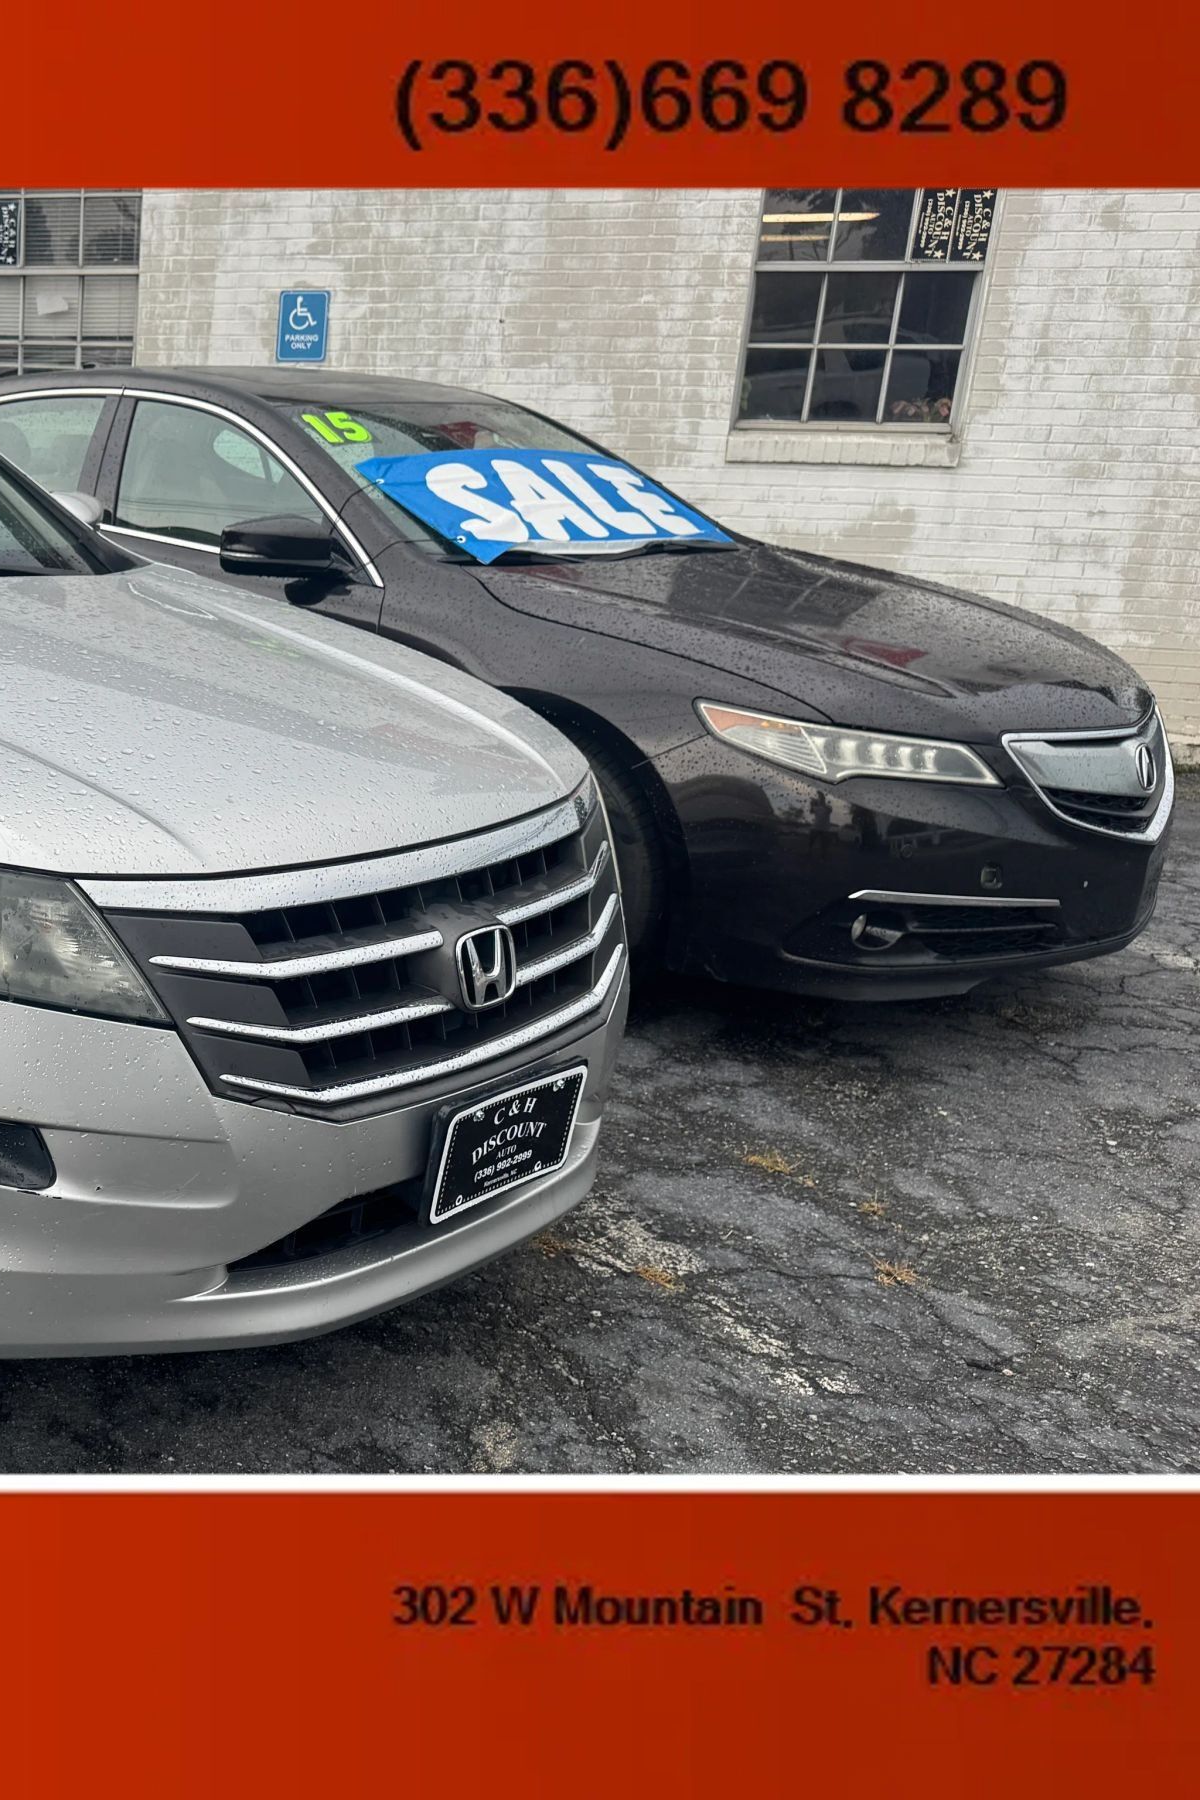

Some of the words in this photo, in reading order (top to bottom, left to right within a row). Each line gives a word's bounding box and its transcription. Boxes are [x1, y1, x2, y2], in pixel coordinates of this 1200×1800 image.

[924, 192, 946, 257] DISCOUNT
[962, 194, 984, 259] DISCOUNT
[983, 208, 992, 218] C
[284, 334, 319, 342] PARKING
[290, 342, 312, 350] ONLY
[301, 411, 373, 443] 15
[425, 458, 704, 543] SALE
[493, 1106, 506, 1126] C
[508, 1099, 523, 1117] &
[523, 1097, 538, 1114] H
[471, 1121, 548, 1166] DISCOUNT
[495, 1144, 517, 1160] AUTO
[474, 1164, 495, 1183] (336)
[496, 1149, 533, 1172] 992-2999
